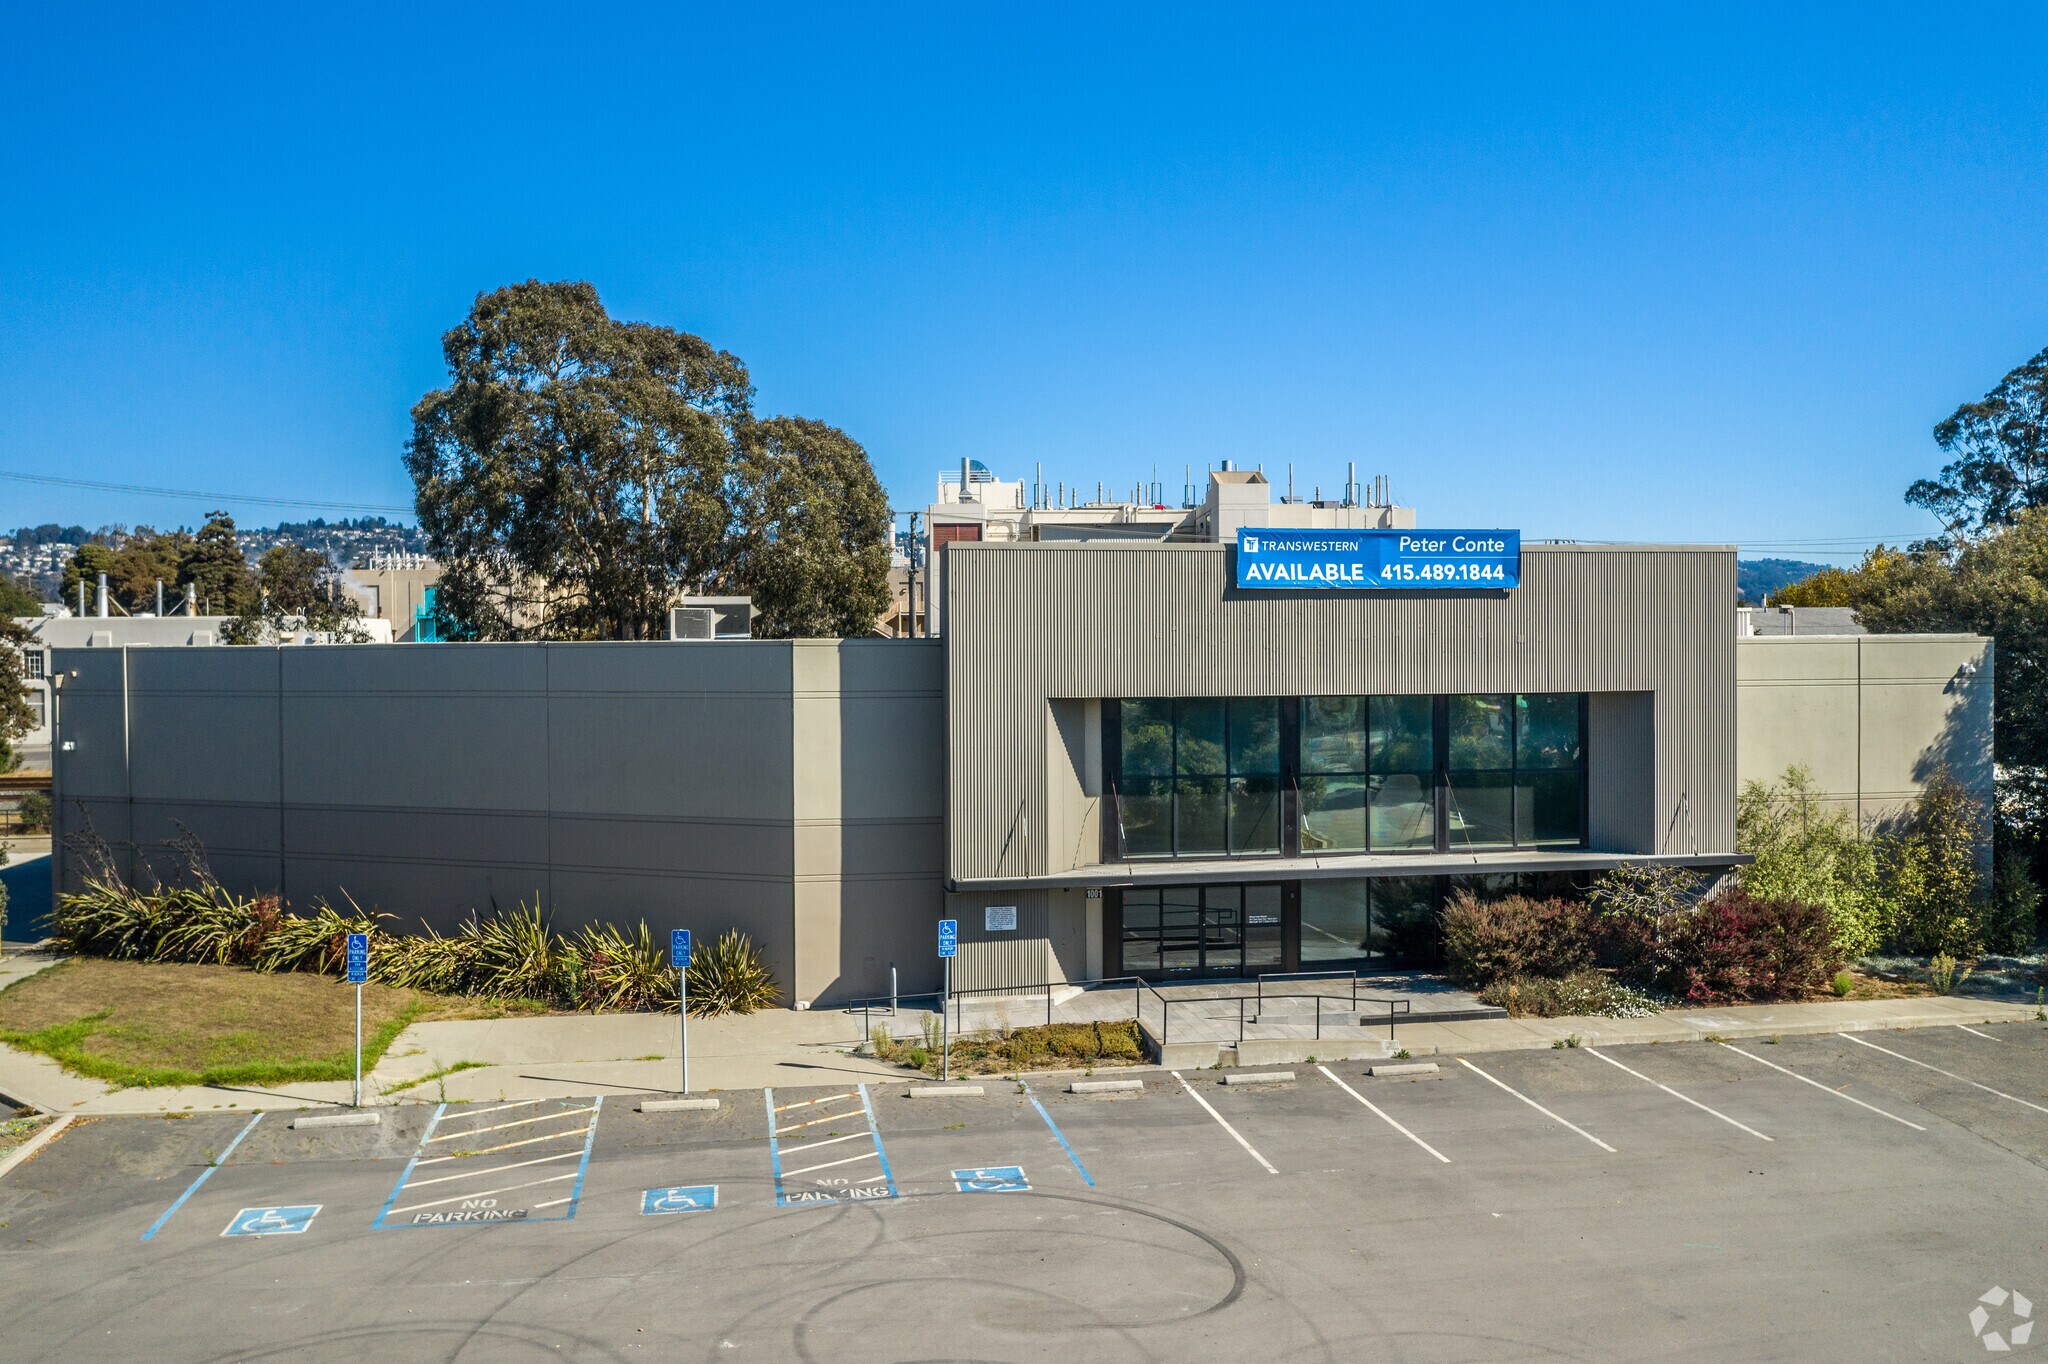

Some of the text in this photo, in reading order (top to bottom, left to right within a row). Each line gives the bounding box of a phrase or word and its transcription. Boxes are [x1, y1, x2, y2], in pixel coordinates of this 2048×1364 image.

[1262, 541, 1359, 551] TRANSWESTERN
[1400, 536, 1505, 552] Peter Conte
[1246, 563, 1364, 580] AVAILABLE
[1381, 564, 1505, 581] 415.489.1844
[1087, 889, 1102, 898] 1001
[461, 1199, 498, 1209] NO
